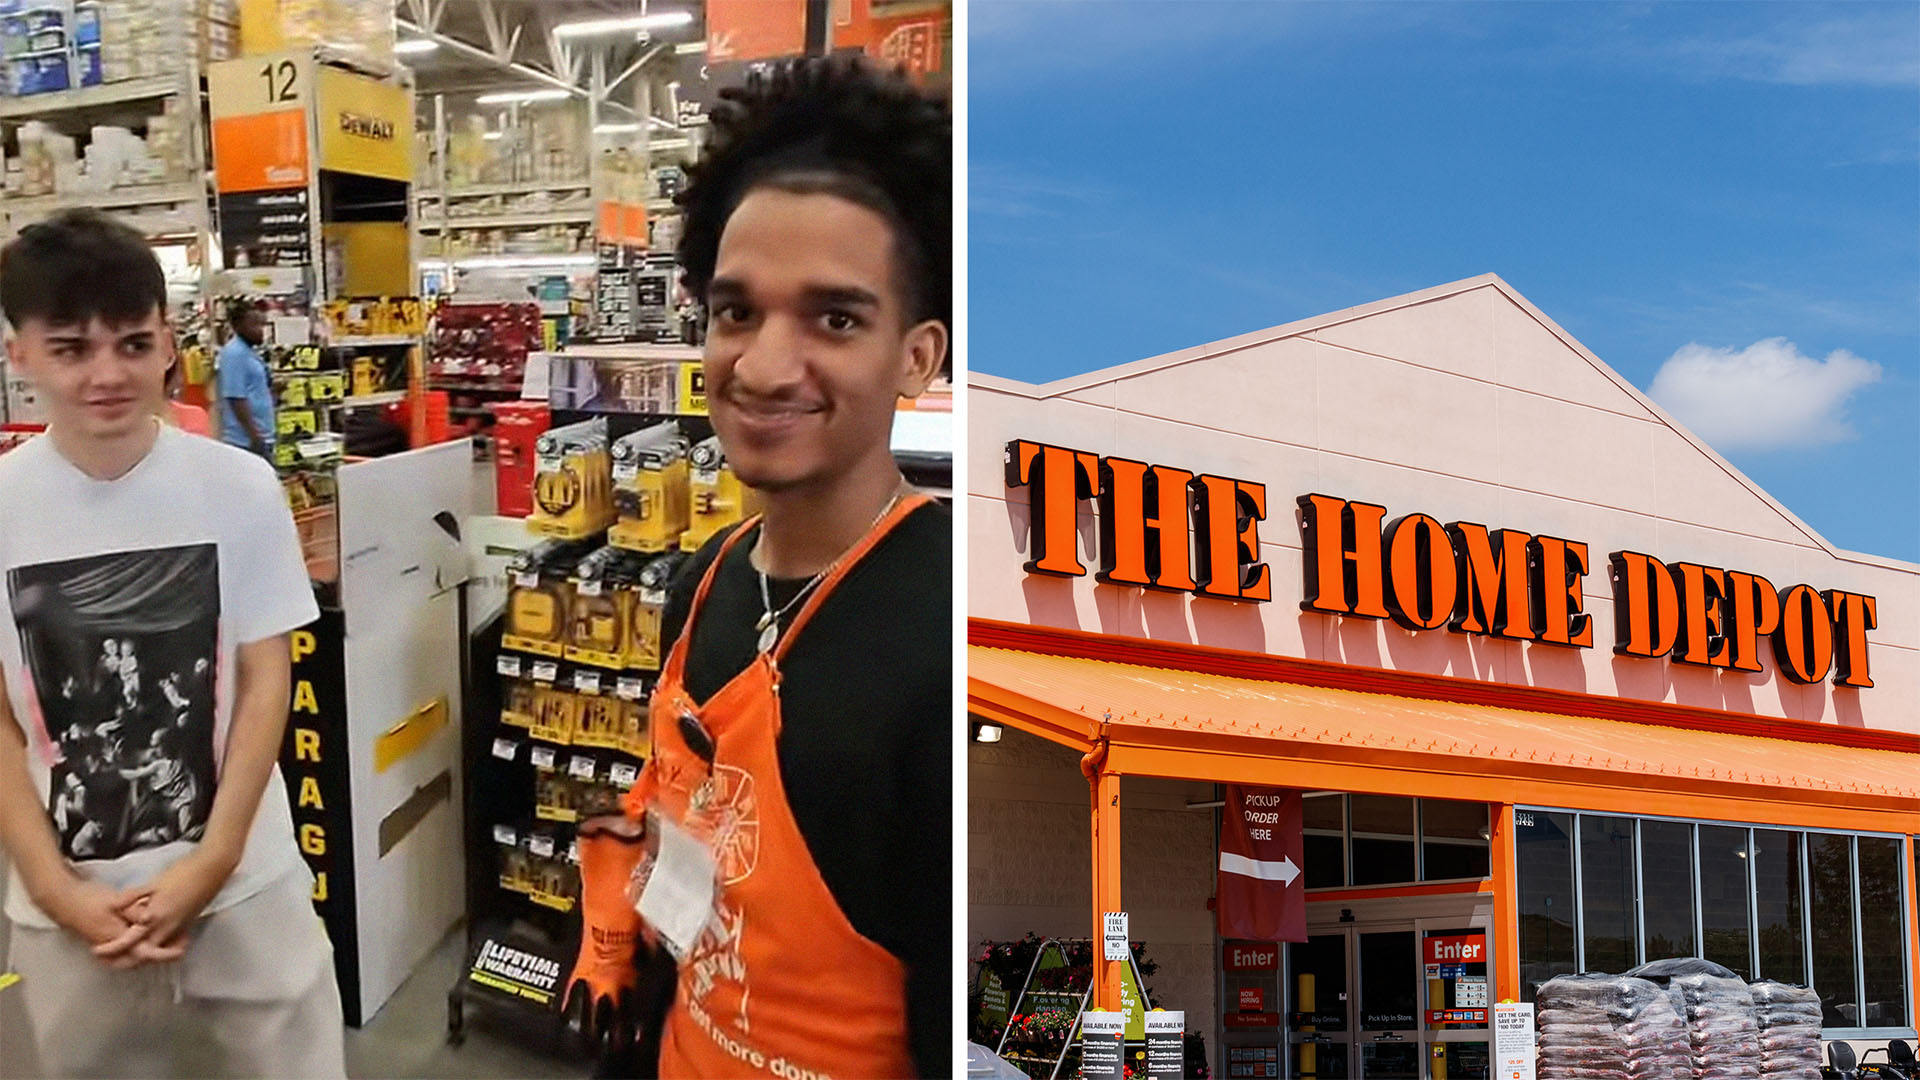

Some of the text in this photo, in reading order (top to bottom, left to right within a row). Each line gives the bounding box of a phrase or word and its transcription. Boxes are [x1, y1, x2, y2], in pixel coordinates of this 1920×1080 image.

[261, 60, 298, 103] 12
[340, 112, 394, 141] DEWALT
[1004, 438, 1878, 688] THE HOME DEPOT
[1245, 794, 1280, 807] PICKUP
[1244, 810, 1279, 824] ORDER
[1249, 828, 1272, 840] HERE
[1233, 949, 1274, 967] Enter
[1434, 940, 1480, 959] Enter
[489, 943, 560, 977] LIFETIME
[484, 958, 556, 989] WARRANTY
[1109, 1022, 1122, 1030] NOW
[1312, 1016, 1321, 1024] Buy
[712, 1027, 765, 1068] more
